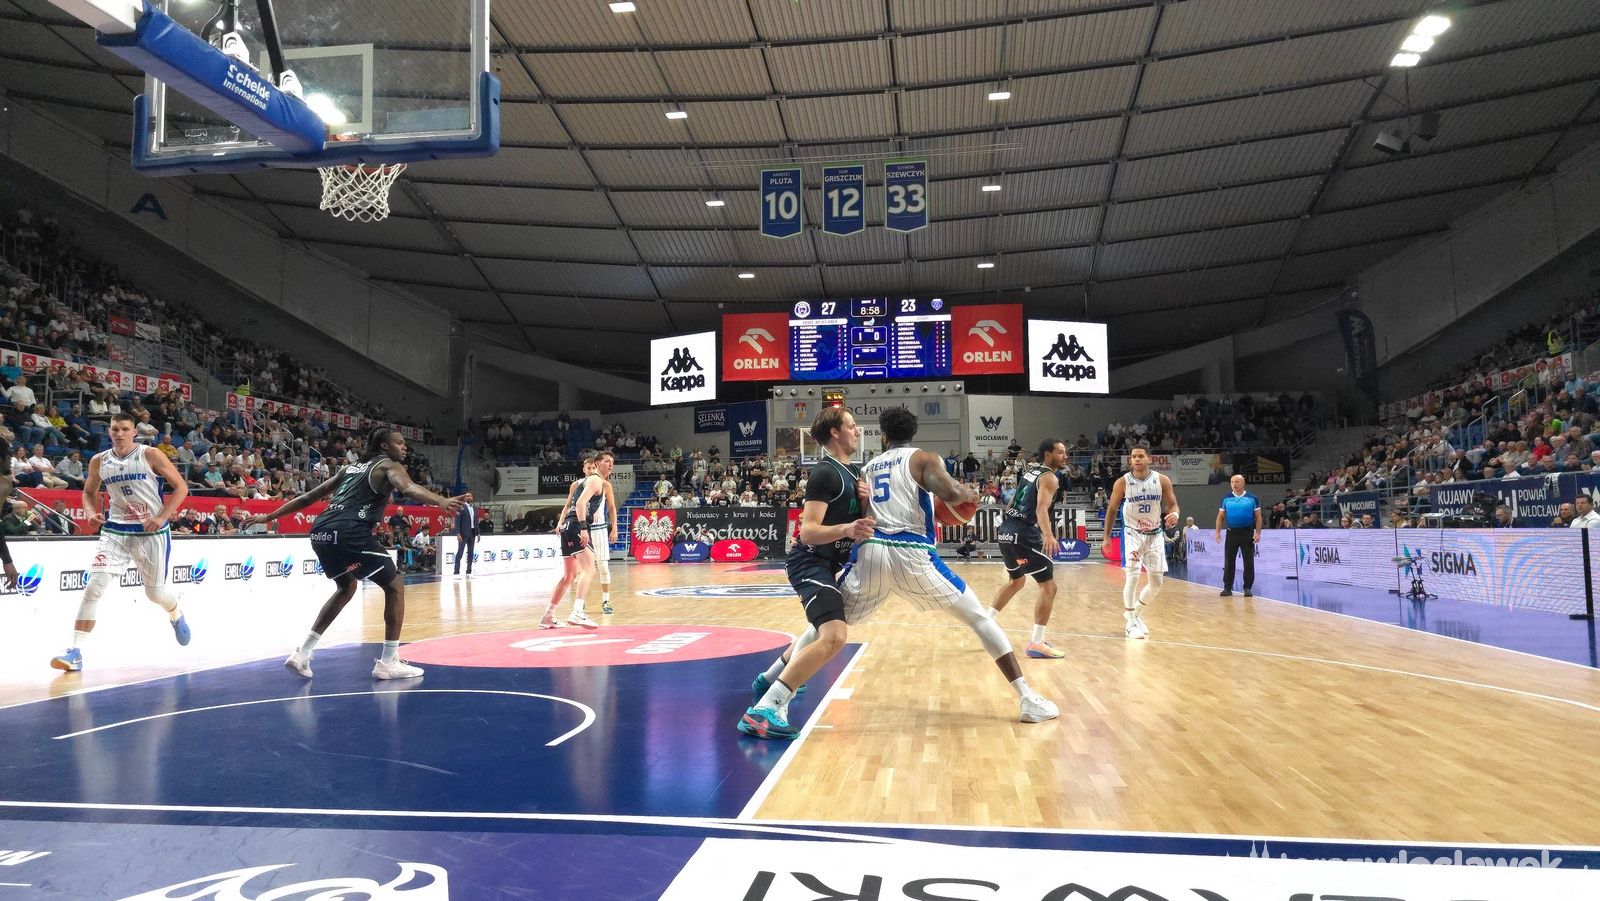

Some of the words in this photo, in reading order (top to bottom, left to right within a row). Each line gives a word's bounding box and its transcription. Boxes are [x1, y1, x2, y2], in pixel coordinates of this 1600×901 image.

[769, 177, 793, 185] PLUTA
[824, 174, 863, 183] GRISZCZUK
[886, 170, 926, 179] SZEWCZYK
[765, 191, 798, 220] 10
[827, 188, 860, 218] 12
[888, 184, 926, 214] 33
[128, 192, 168, 220] A
[821, 302, 836, 315] 27
[860, 306, 880, 315] 8:58
[901, 299, 916, 312] 23
[874, 331, 880, 341] 0
[963, 350, 1012, 363] ORLEN
[733, 357, 779, 370] ORLEN
[1042, 361, 1096, 381] Kappa
[660, 374, 705, 392] Kappa
[697, 411, 726, 424] SELENKA
[866, 457, 902, 473] FREEMAN
[120, 485, 134, 496] 16
[872, 473, 891, 503] 5
[1518, 488, 1547, 501] POWIAT
[1437, 489, 1474, 505] KUJAWY
[1138, 504, 1151, 513] 20
[1314, 546, 1341, 564] SIGMA
[1432, 551, 1476, 576] SIGMA
[61, 572, 82, 591] ENBL
